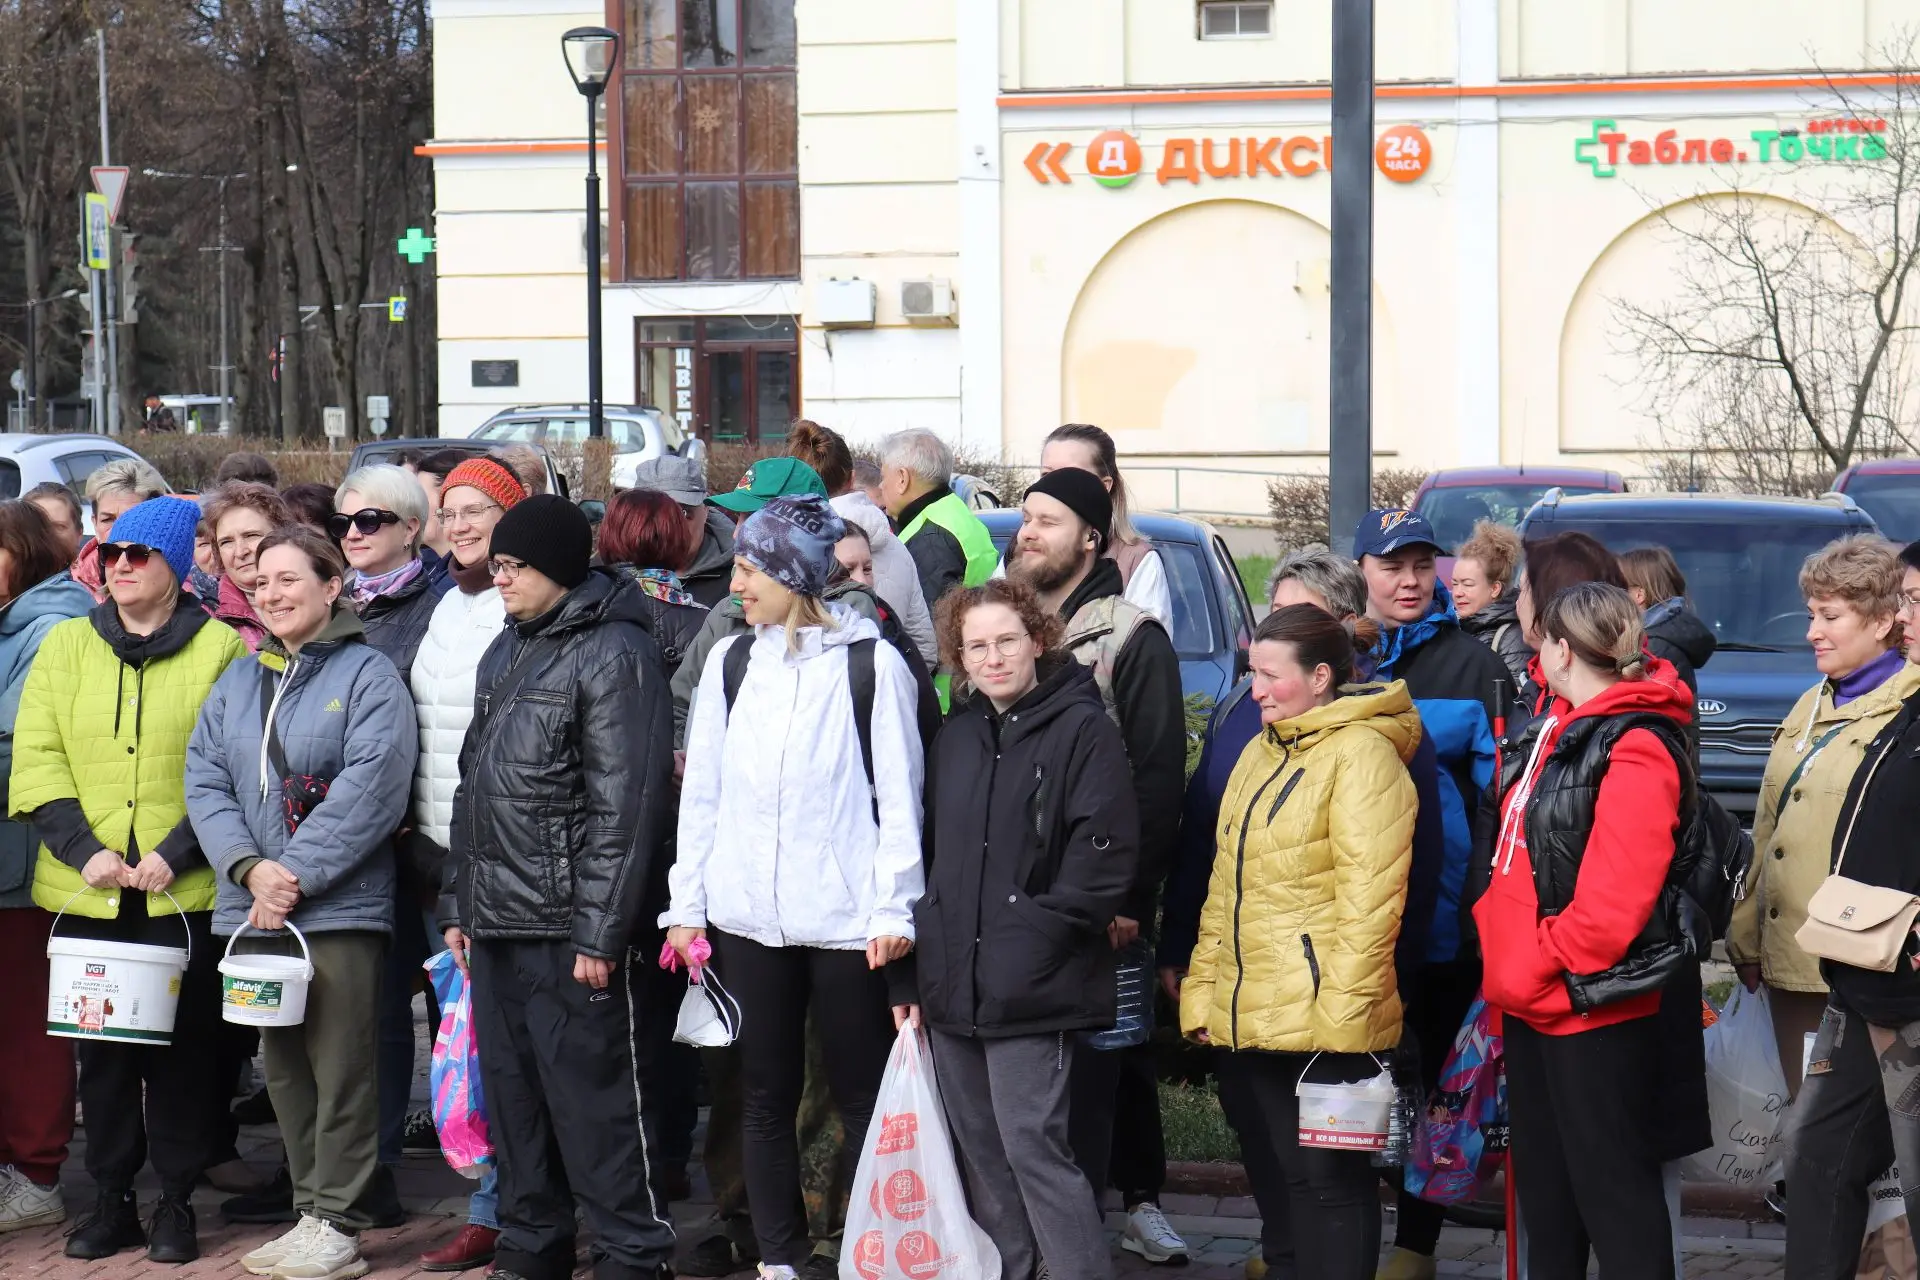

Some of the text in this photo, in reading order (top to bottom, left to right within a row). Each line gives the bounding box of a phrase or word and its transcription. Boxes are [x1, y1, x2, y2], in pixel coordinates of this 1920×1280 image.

[1385, 135, 1421, 158] 24
[1156, 136, 1332, 186] ДИКС
[1384, 159, 1422, 171] ЧАСА
[675, 348, 696, 439] ЦВЕТ
[87, 965, 106, 974] VGT
[232, 981, 262, 992] alfavit
